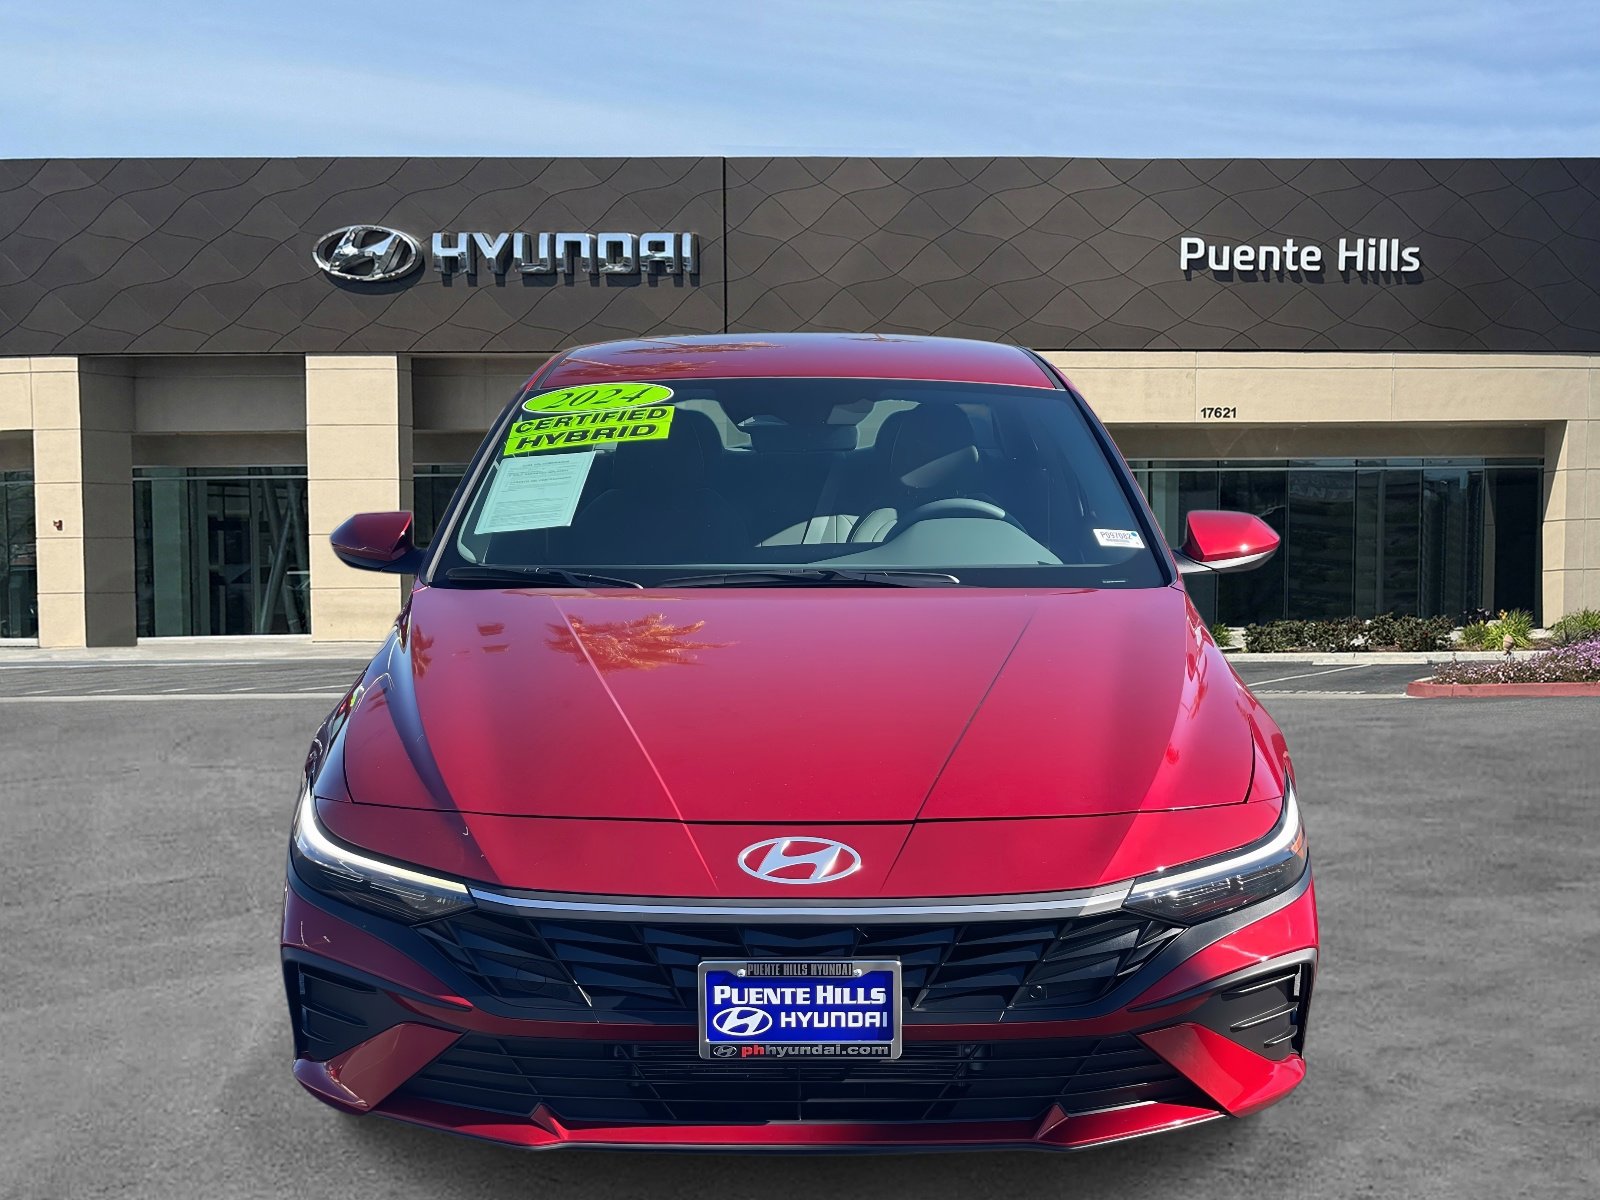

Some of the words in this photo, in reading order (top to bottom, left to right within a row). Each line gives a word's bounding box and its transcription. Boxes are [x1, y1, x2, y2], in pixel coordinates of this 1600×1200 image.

[432, 232, 700, 274] HYUNDAI
[1180, 237, 1322, 271] Puente
[1338, 238, 1421, 272] Hills
[542, 386, 654, 410] 2024
[515, 406, 669, 434] CERTIFIED
[1200, 407, 1237, 419] 17621
[515, 423, 659, 450] HYBRID
[747, 963, 780, 976] PUENTE
[783, 963, 808, 976] HILLS
[811, 963, 852, 976] HYUNDAI
[713, 985, 811, 1005] PUENTE
[816, 985, 887, 1005] HILLS
[780, 1012, 887, 1028] HYUNDAI
[741, 1043, 889, 1058] phhyundai.com
